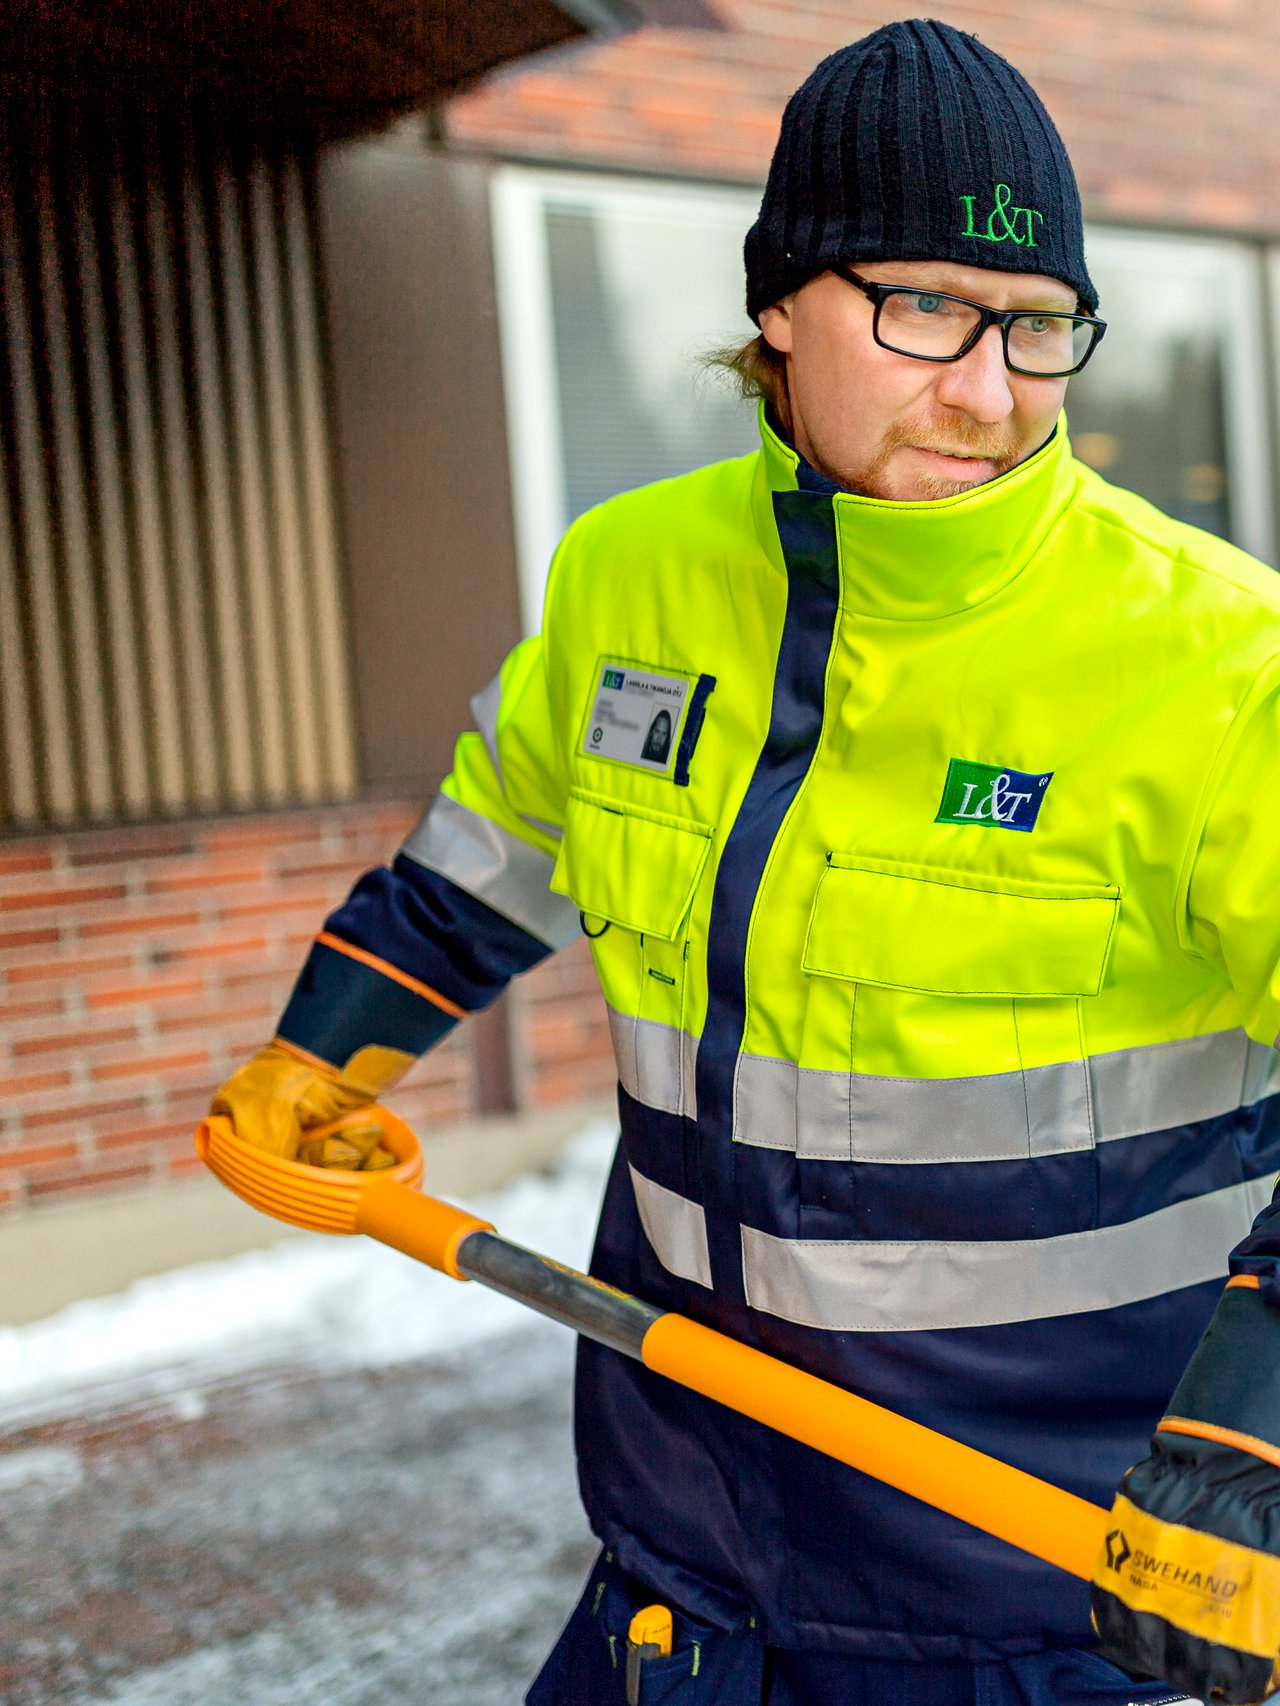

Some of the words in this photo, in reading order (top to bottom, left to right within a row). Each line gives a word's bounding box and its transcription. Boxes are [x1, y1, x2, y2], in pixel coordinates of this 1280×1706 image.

[959, 183, 1043, 247] L&T
[952, 773, 1033, 823] L&T
[1131, 1549, 1239, 1599] SWEHAND
